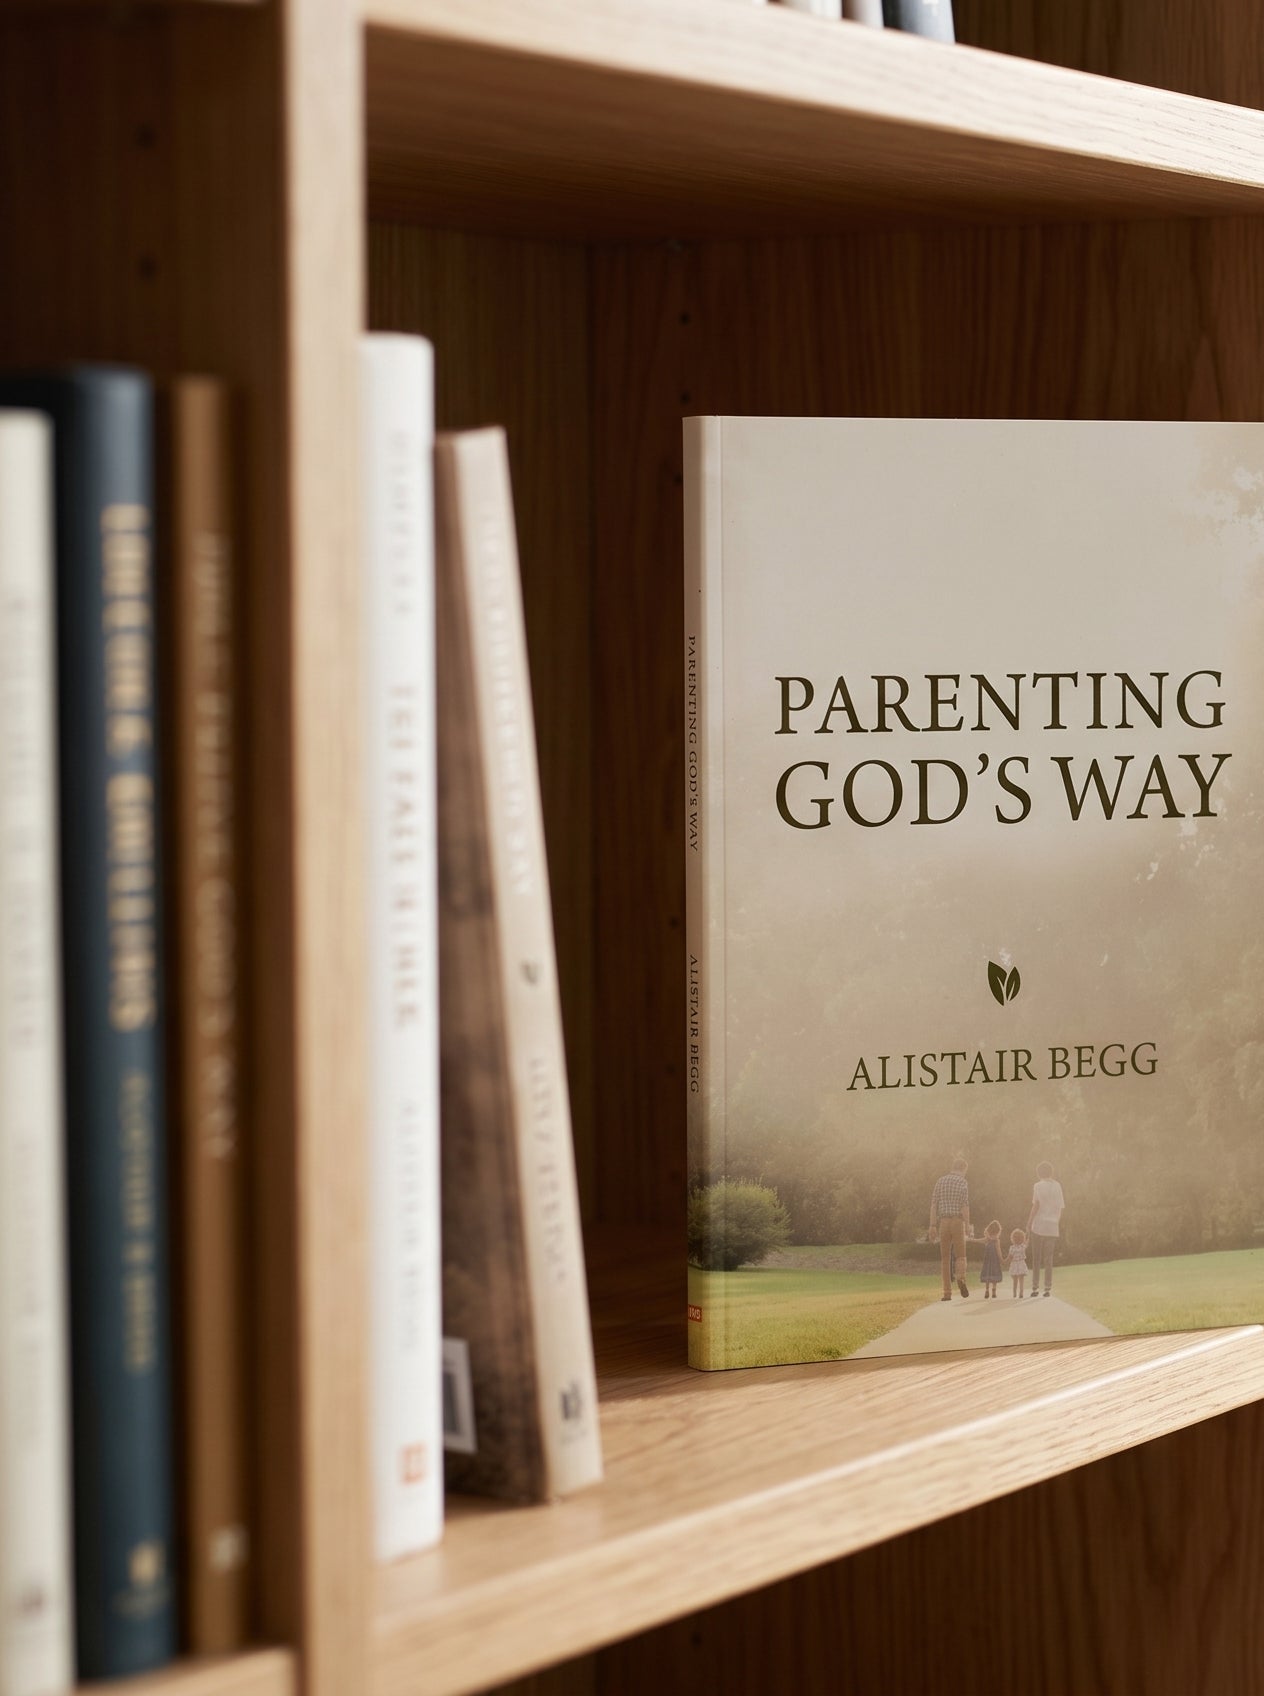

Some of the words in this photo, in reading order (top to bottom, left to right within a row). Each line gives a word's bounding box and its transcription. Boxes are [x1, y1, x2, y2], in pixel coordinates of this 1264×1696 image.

[687, 635, 697, 744] PARENTING
[774, 670, 1226, 735] PARENTING
[775, 752, 1032, 830] GOD’S
[1050, 753, 1233, 821] WAY
[689, 811, 699, 852] WAY
[689, 953, 699, 1038] ALISTAIR
[689, 1043, 700, 1094] BEGG
[845, 1048, 1038, 1091] ALISTAIR
[1047, 1041, 1159, 1080] BEGG
